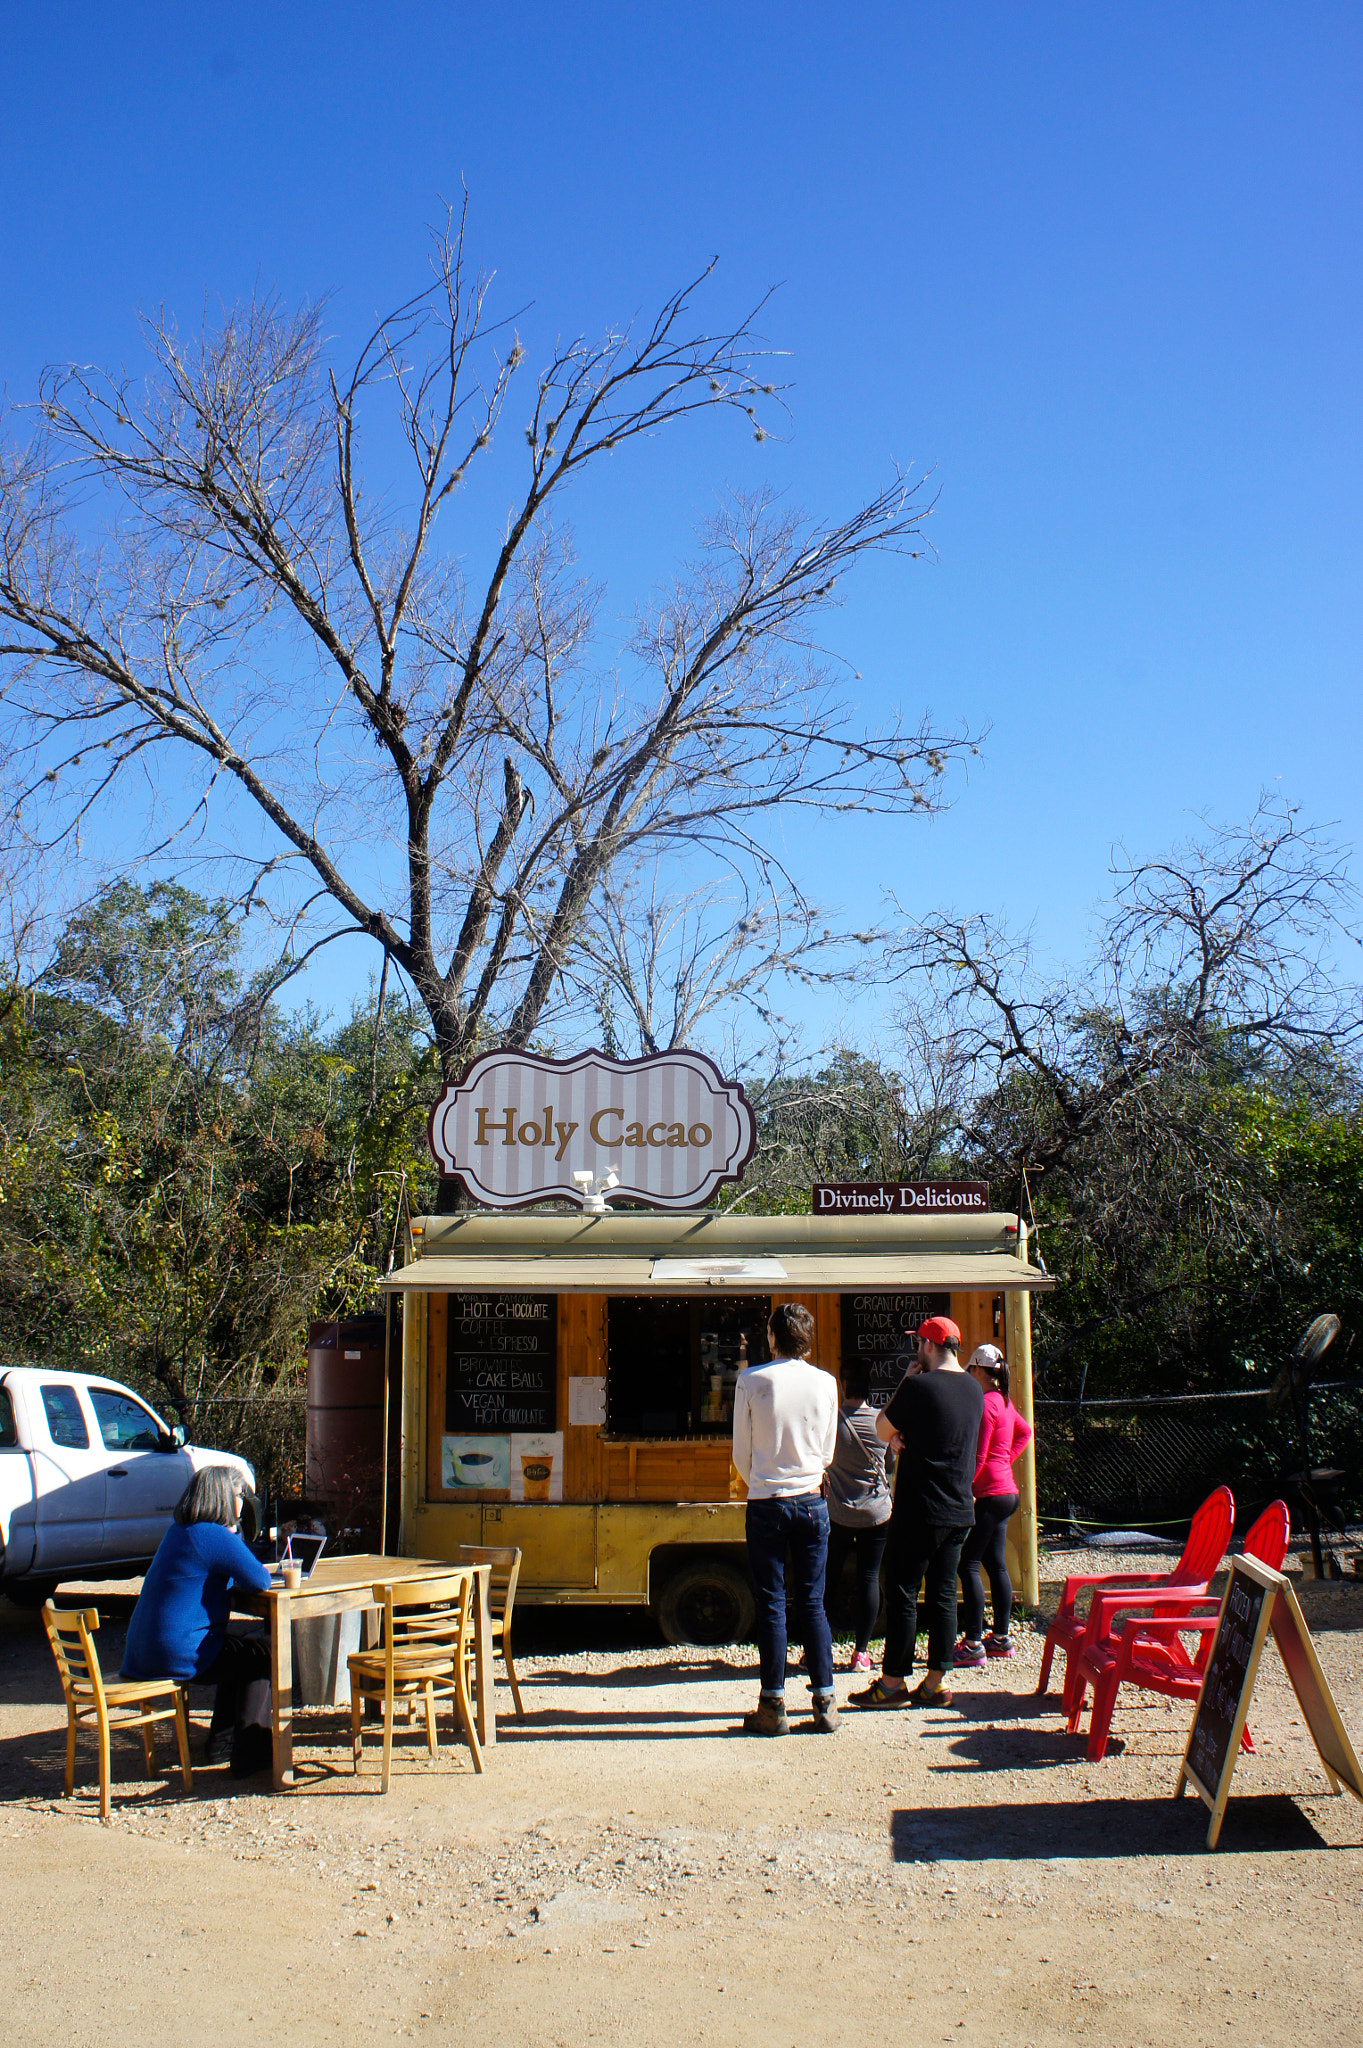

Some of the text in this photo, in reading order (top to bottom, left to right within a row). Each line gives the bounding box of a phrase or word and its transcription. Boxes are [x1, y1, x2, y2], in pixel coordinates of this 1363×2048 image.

[474, 1105, 713, 1161] Holy Cacao
[818, 1187, 986, 1212] Divinely Delicious.
[463, 1303, 549, 1318] HOT CHOCOLATE
[853, 1296, 901, 1311] ORGANIC
[460, 1319, 507, 1335] COFFEE
[854, 1313, 894, 1328] TRADE
[490, 1336, 538, 1351] ESPRESSO
[857, 1333, 906, 1350] ESPRESSO
[459, 1357, 522, 1373] BROWNIES
[861, 1356, 895, 1378] AKE
[476, 1372, 507, 1387] CAKE
[511, 1372, 544, 1388] BALLS
[461, 1393, 505, 1409] VEGAN
[475, 1408, 547, 1425] HOT CHOCOLATE
